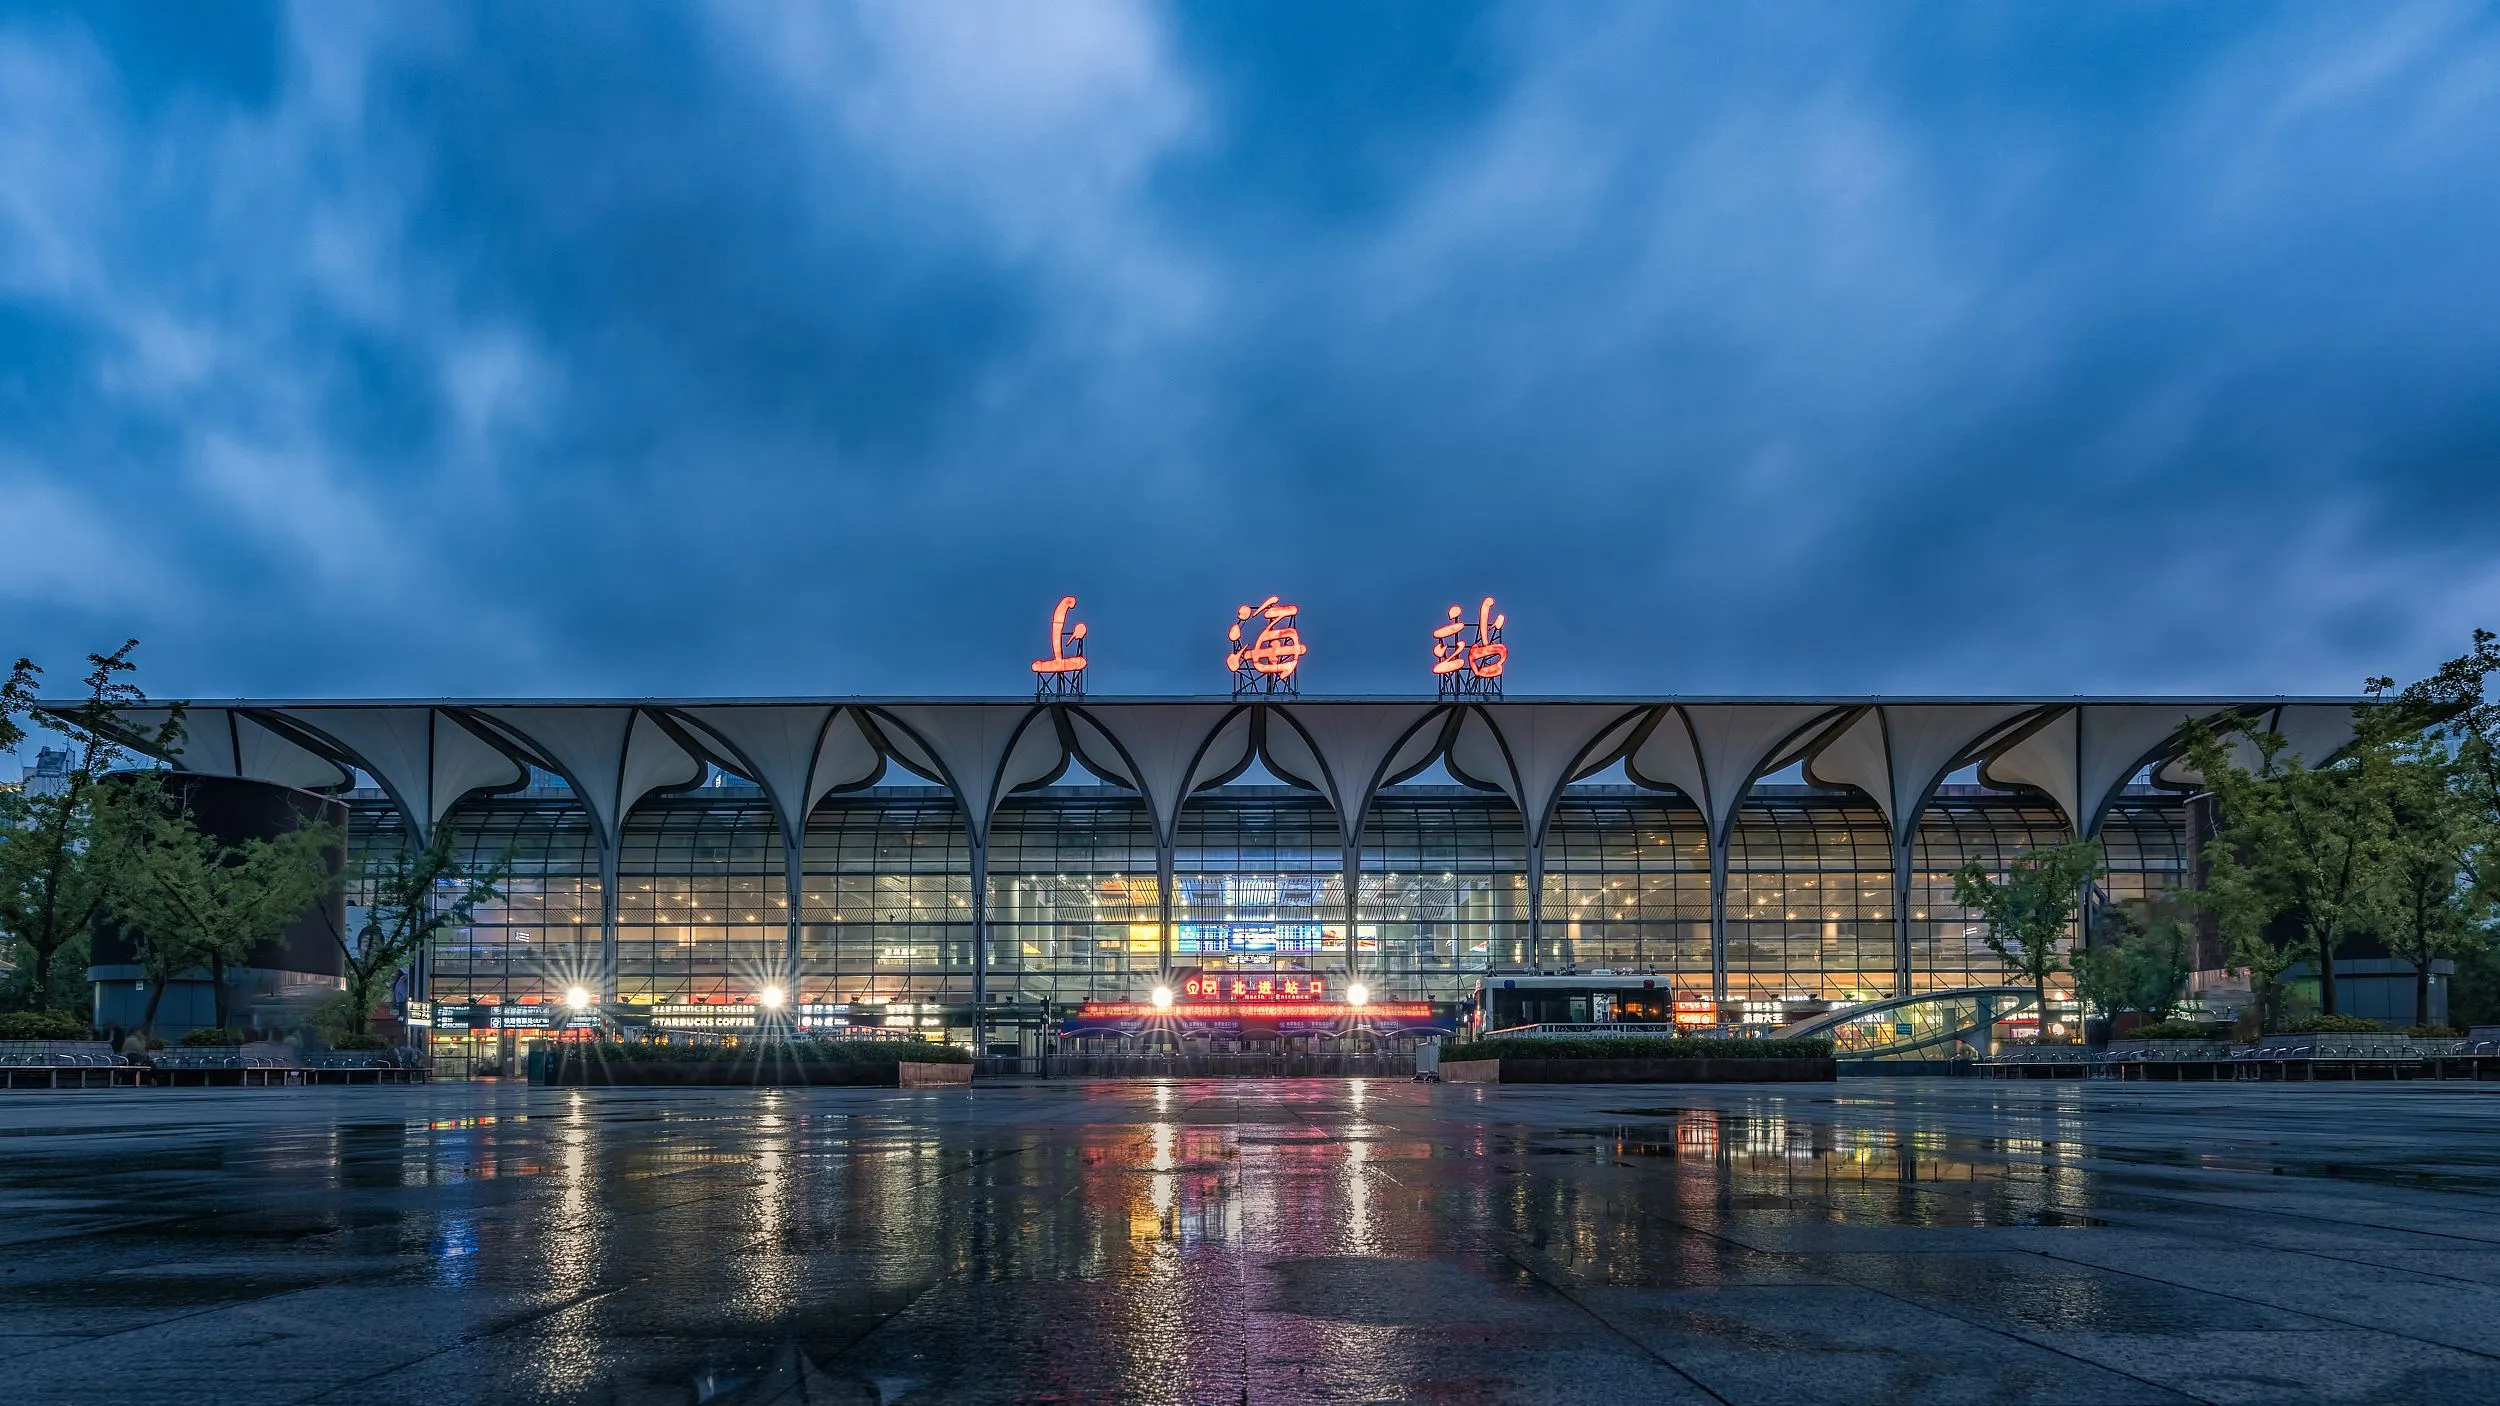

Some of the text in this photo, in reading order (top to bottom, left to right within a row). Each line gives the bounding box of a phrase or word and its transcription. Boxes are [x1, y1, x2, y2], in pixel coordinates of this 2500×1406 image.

[1031, 596, 1507, 679] 上海站
[1232, 980, 1322, 995] 北进站口
[715, 1017, 755, 1026] COFFEE
